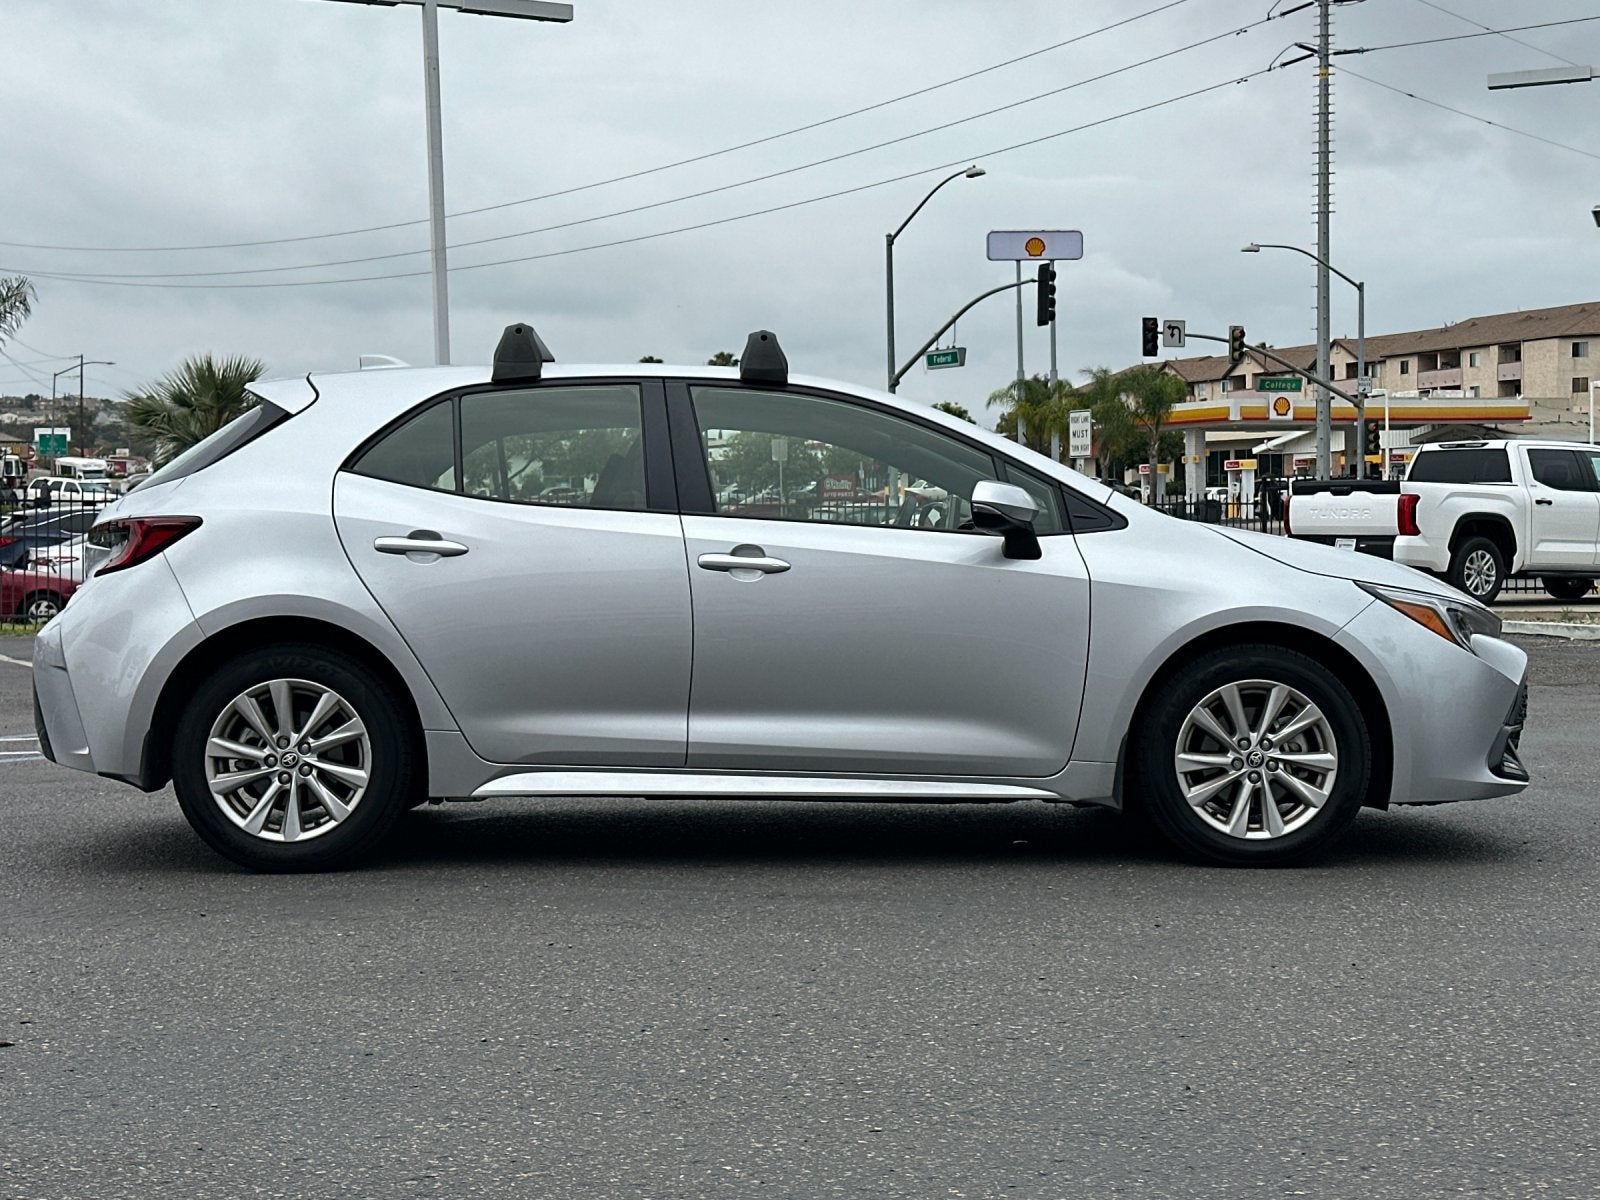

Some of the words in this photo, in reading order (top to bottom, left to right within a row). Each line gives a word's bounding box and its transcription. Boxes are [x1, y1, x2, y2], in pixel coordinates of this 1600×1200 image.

[933, 354, 952, 363] Federal
[1264, 381, 1296, 390] College
[1081, 415, 1089, 423] LANE
[1072, 429, 1088, 438] MUST
[1309, 508, 1372, 519] TUNDRA
